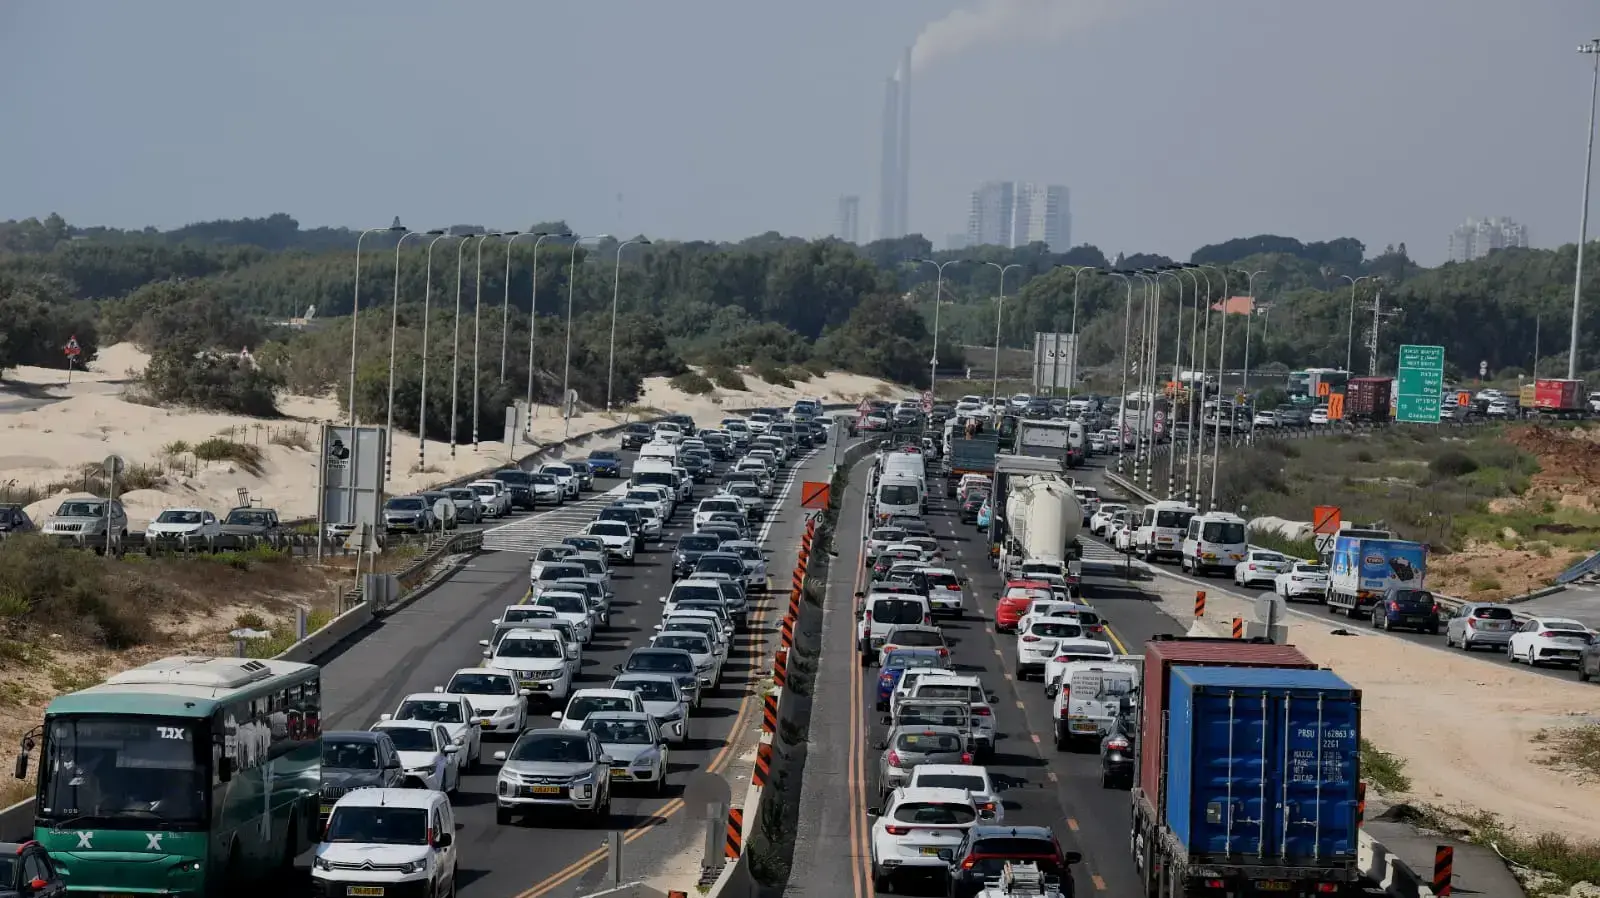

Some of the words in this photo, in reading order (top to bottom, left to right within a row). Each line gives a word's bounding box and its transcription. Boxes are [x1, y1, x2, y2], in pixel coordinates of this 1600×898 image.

[804, 512, 824, 523] 70
[1317, 538, 1335, 549] 70
[156, 726, 185, 740] אגד
[1297, 729, 1315, 738] PRSU
[1324, 729, 1347, 738] 162863
[1323, 740, 1339, 748] 22G1
